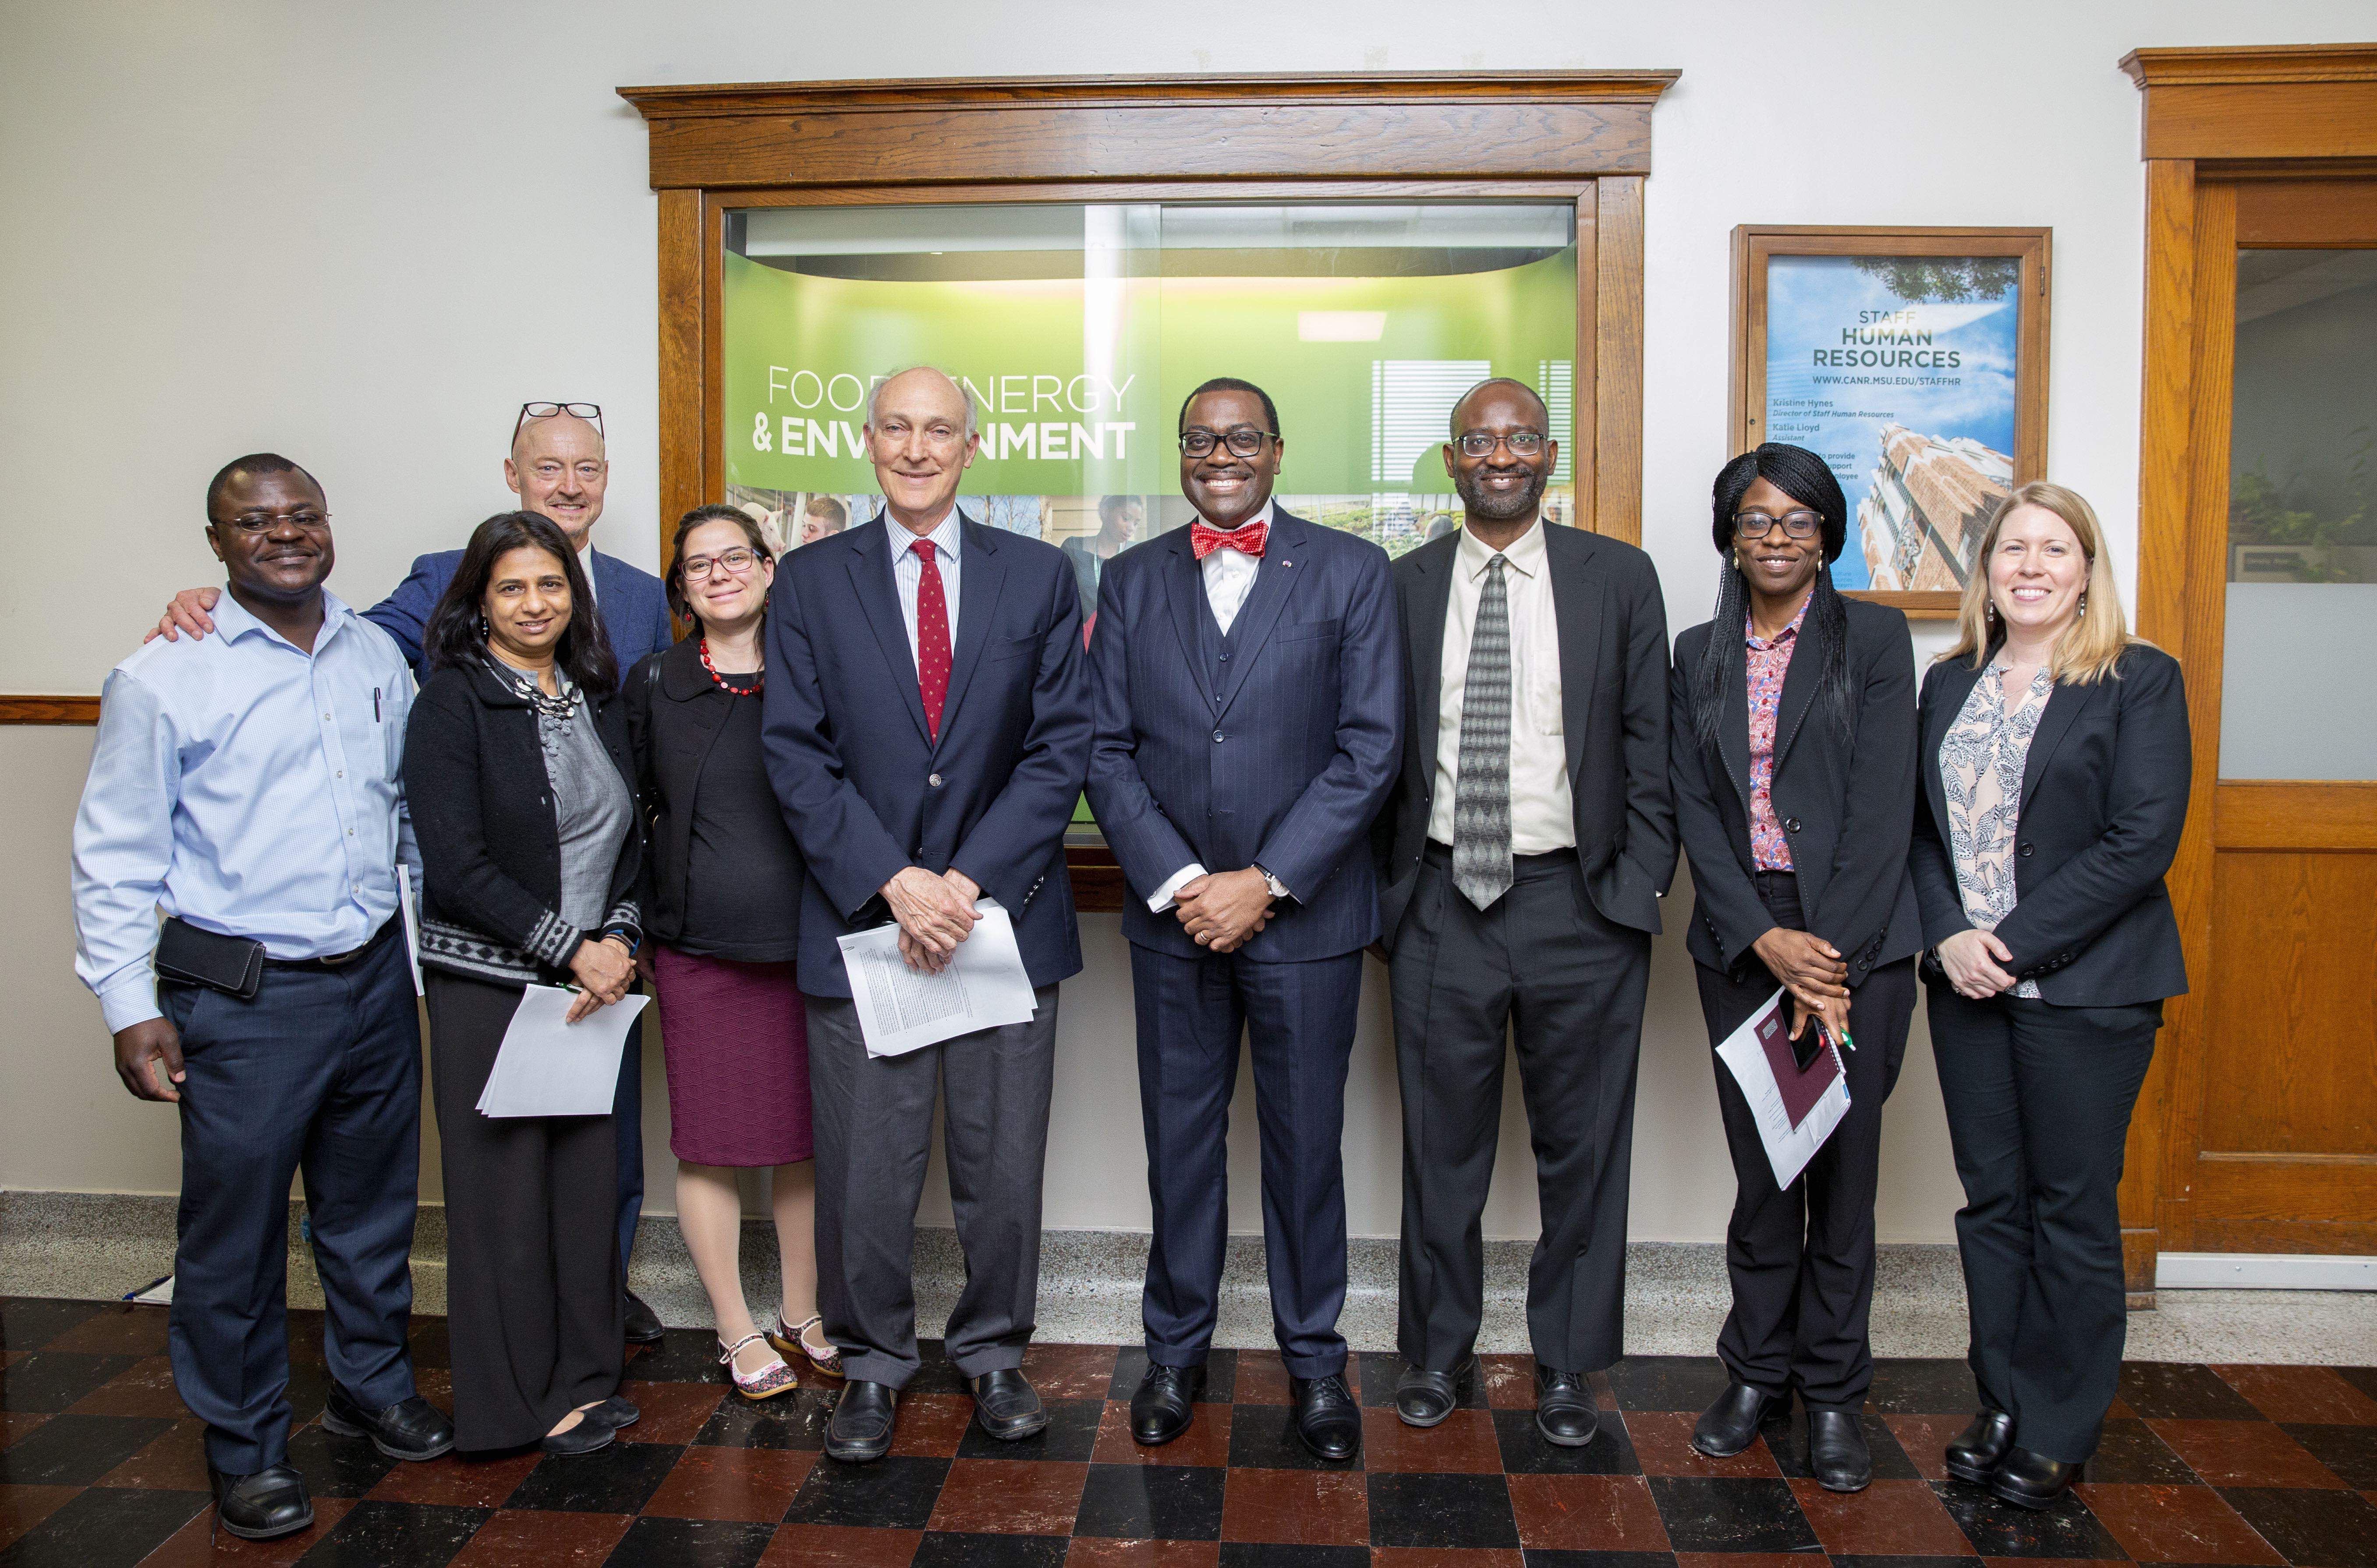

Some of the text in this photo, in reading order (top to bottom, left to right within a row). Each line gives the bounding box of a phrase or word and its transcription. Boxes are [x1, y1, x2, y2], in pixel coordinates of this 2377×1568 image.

[1859, 311, 1916, 323] STAFF
[1842, 328, 1932, 346] HUMAN
[1813, 350, 1961, 368] RESOURCES
[1812, 376, 1961, 386] WWW.CANR.MSU.EDU/STAFFHR
[949, 374, 1136, 413] NERGY
[1773, 399, 1834, 408] Kristine Hynes
[752, 411, 1136, 460] & ENVNMENT
[1797, 424, 1820, 433] Lloyd
